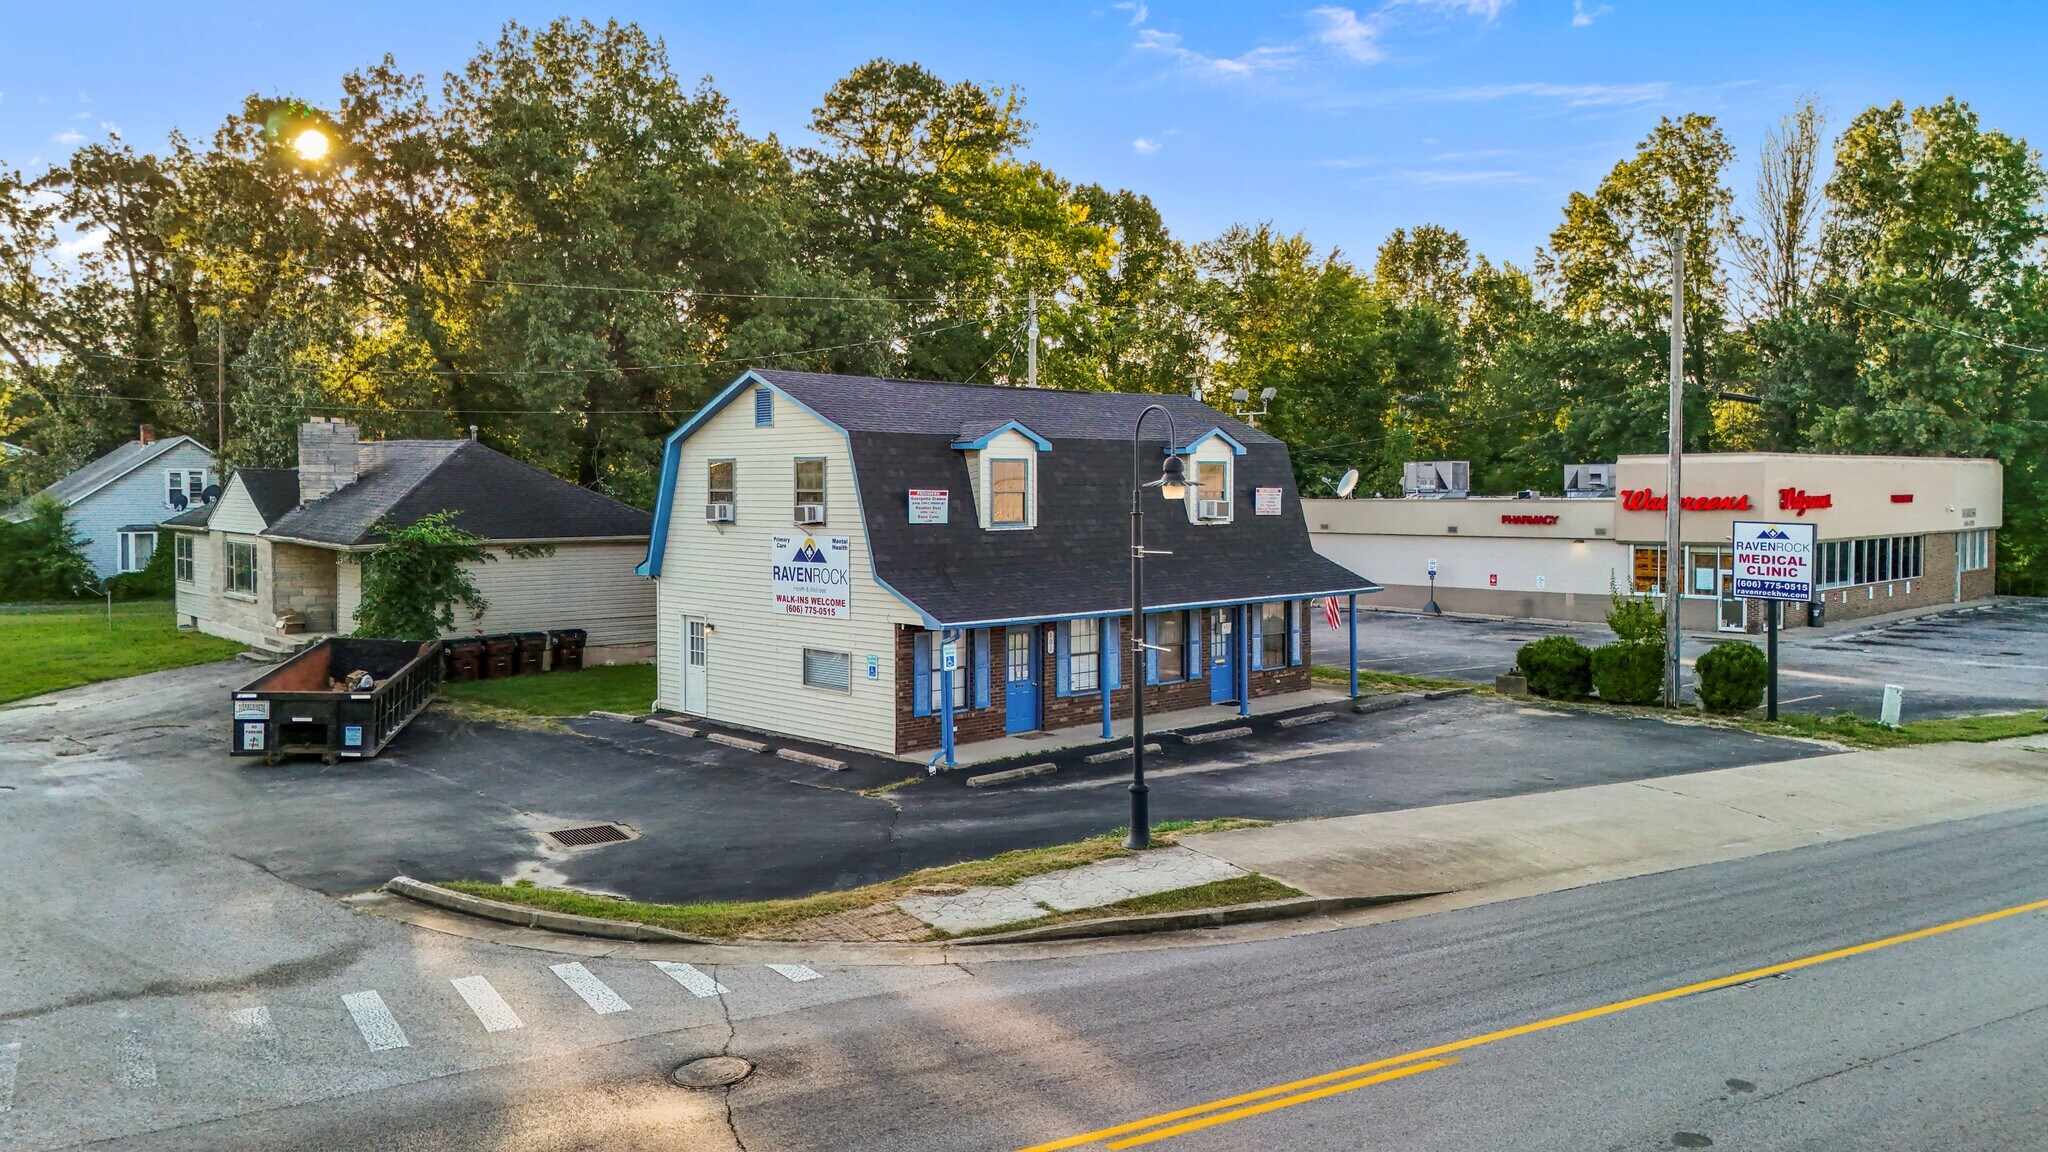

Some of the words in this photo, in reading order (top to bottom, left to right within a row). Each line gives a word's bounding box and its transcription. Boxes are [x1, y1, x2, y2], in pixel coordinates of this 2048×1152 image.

[1621, 488, 1753, 514] Walreens
[1501, 515, 1559, 526] PHARMACY
[1736, 542, 1810, 552] RAVENROCK
[1738, 554, 1807, 566] MEDICAL
[773, 566, 848, 585] RAVENROCK
[1746, 566, 1798, 578] CLINIC
[1737, 580, 1761, 588] (606)
[1764, 582, 1808, 591] 775-0515
[1737, 589, 1808, 598] ravenrockhw.com
[776, 595, 809, 604] WALK-INS
[811, 598, 846, 607] WELCOME
[786, 604, 802, 614] (606)
[805, 606, 835, 616] 775-0515
